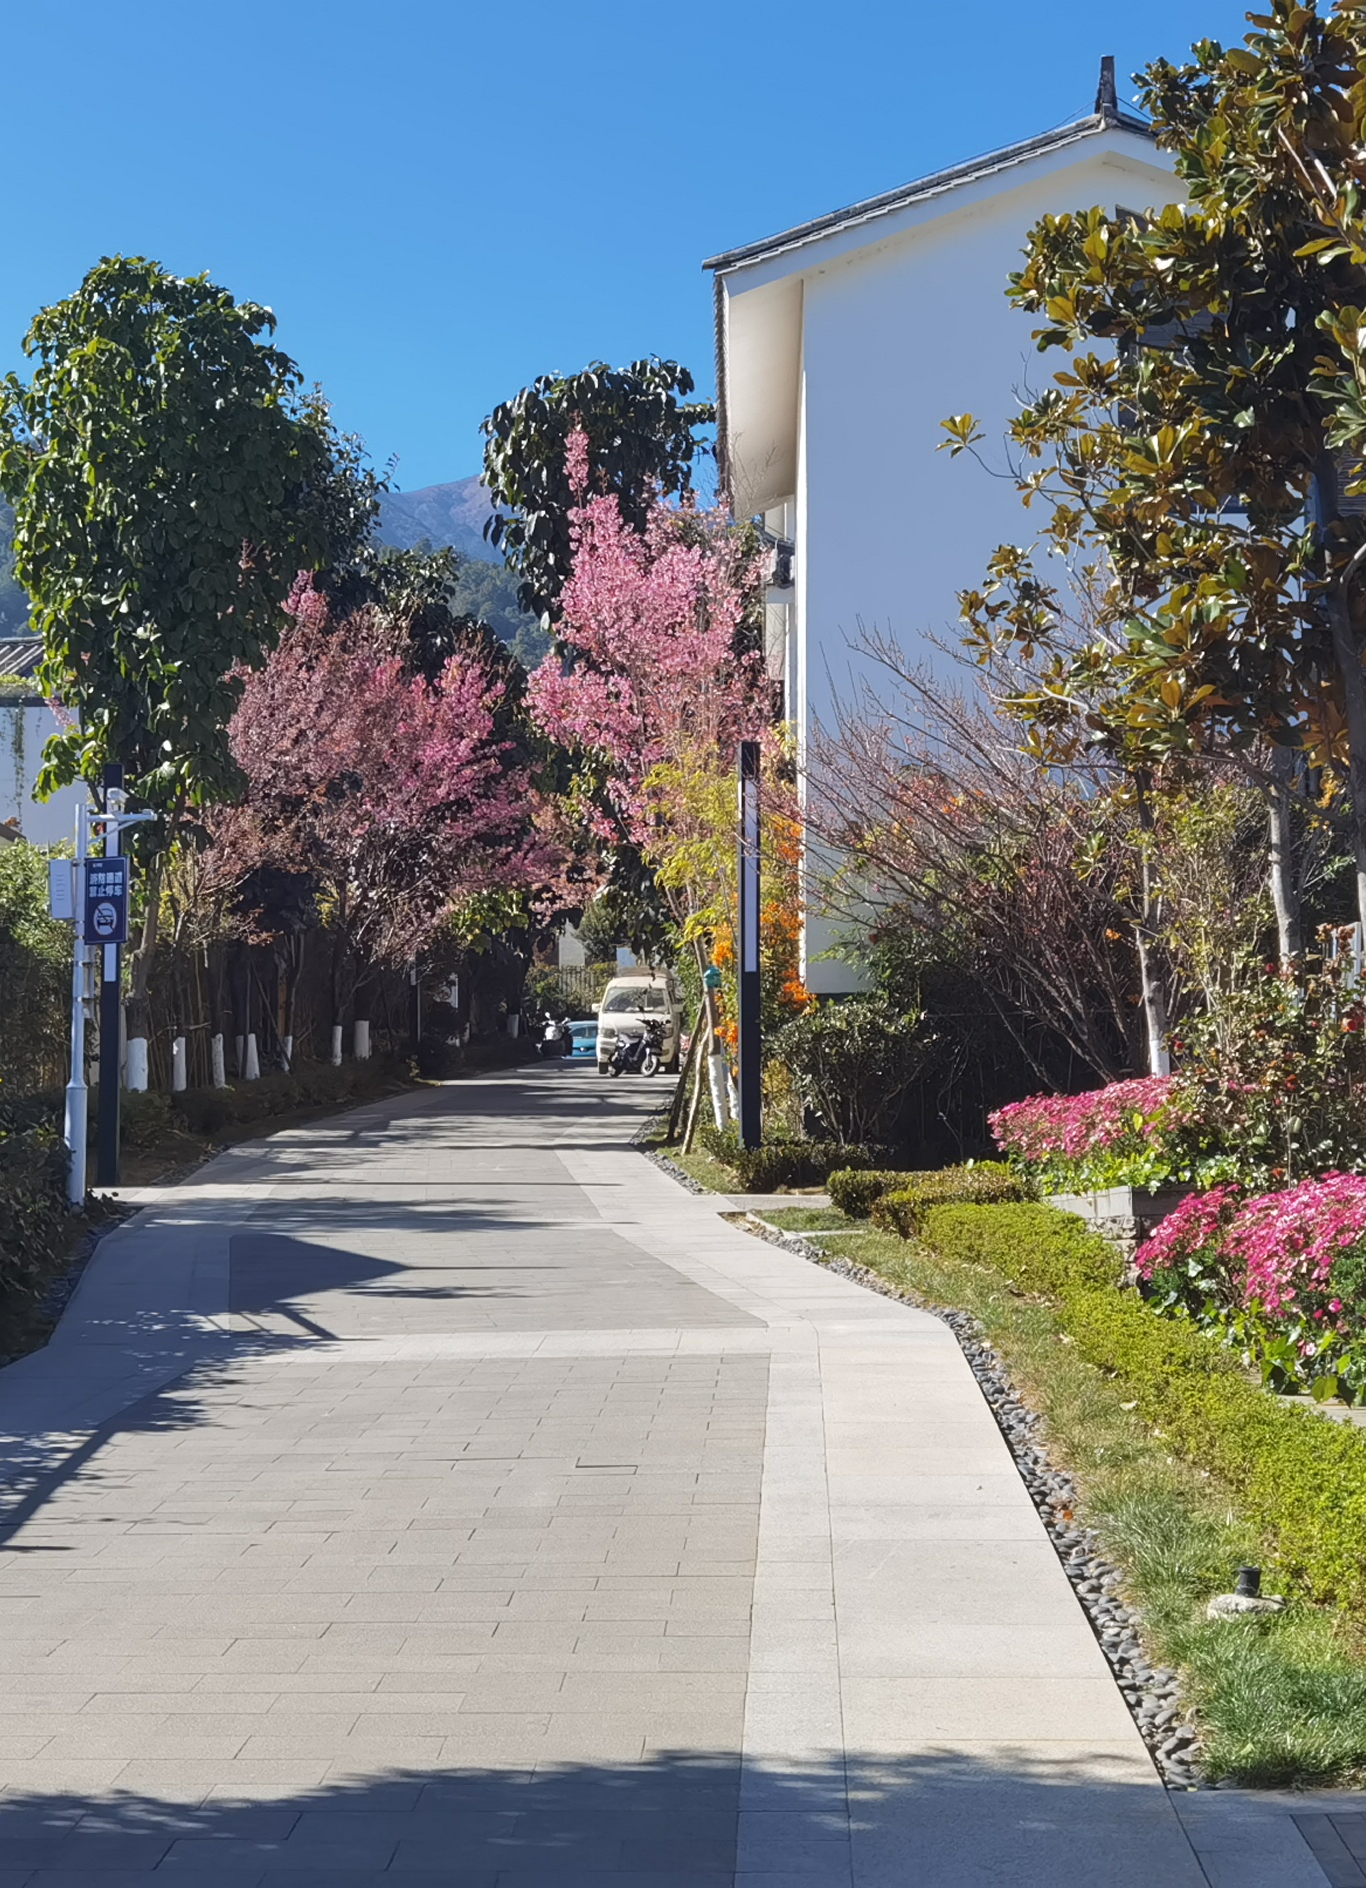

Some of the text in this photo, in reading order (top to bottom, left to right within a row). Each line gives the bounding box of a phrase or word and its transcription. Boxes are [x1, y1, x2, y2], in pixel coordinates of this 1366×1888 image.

[89, 871, 123, 885] 消防通道
[89, 885, 123, 897] 禁止停车
